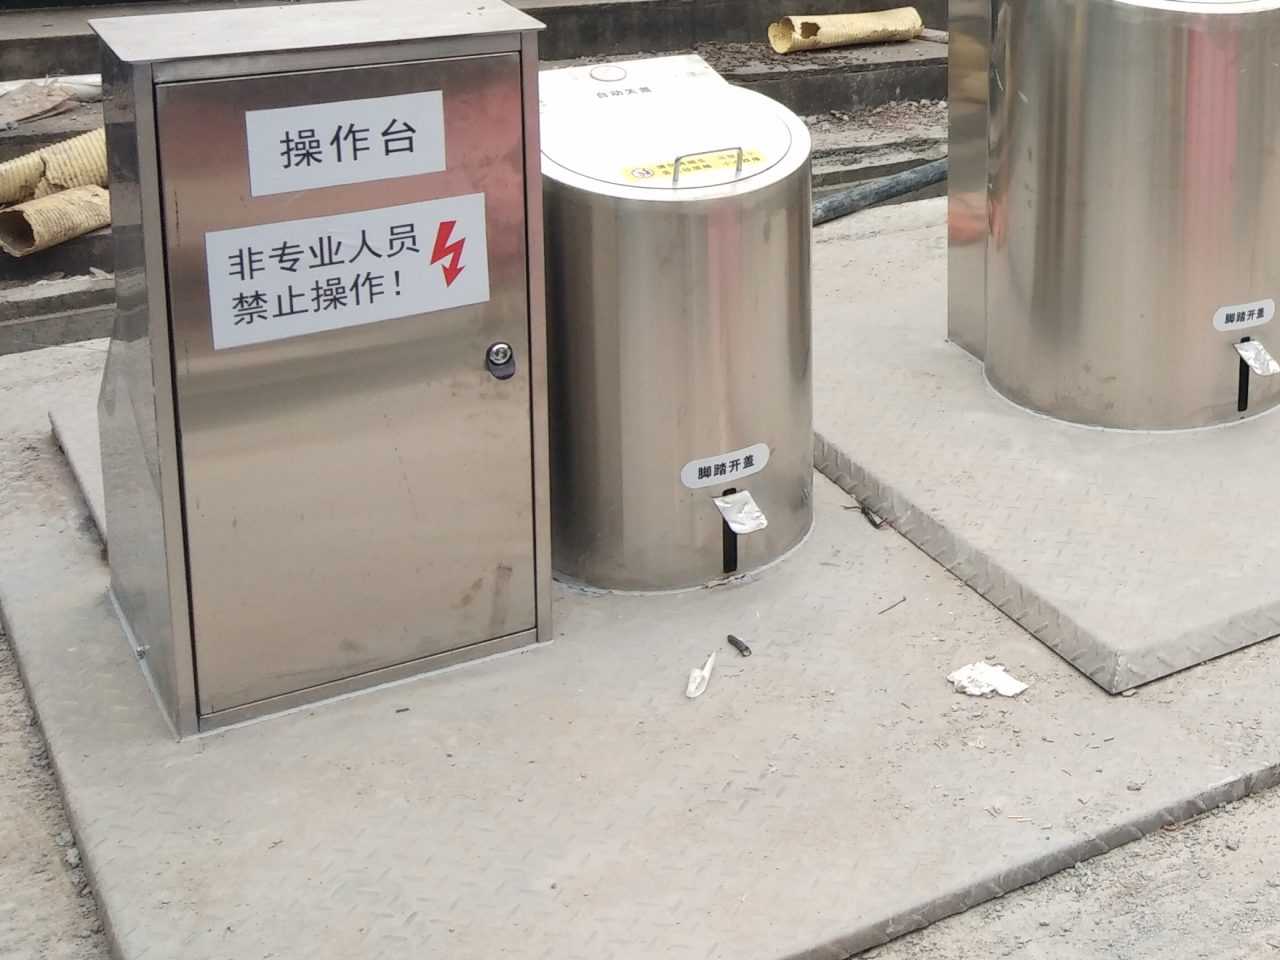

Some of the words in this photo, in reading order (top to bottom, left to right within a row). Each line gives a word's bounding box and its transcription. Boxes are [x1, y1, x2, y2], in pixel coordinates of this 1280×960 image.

[279, 118, 417, 169] 操作台
[228, 223, 420, 281] 非专业人员
[698, 454, 755, 480] 脚踏开盖
